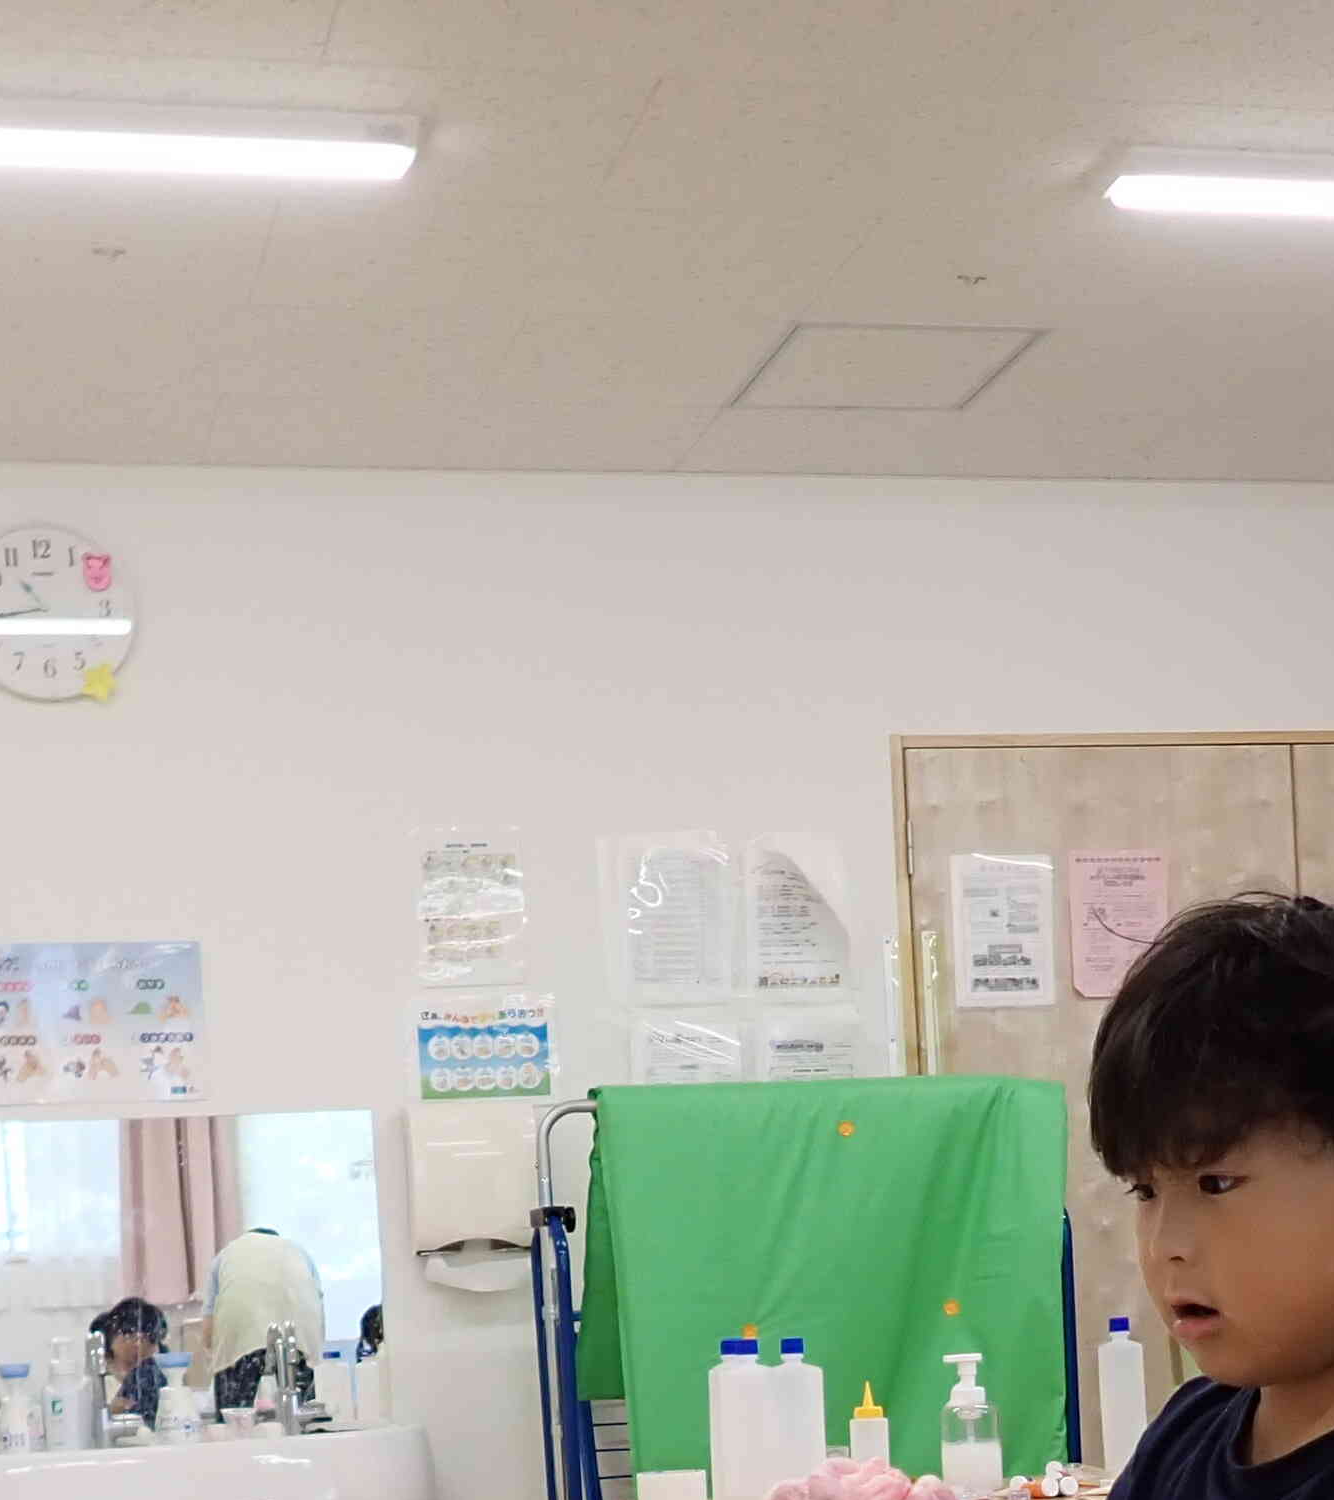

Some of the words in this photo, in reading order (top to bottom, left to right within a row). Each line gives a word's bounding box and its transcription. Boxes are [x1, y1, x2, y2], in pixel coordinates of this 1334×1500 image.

[4, 547, 18, 567] 11
[31, 539, 51, 559] 12
[12, 651, 25, 671] 7
[43, 658, 57, 678] 6
[73, 650, 86, 670] 5
